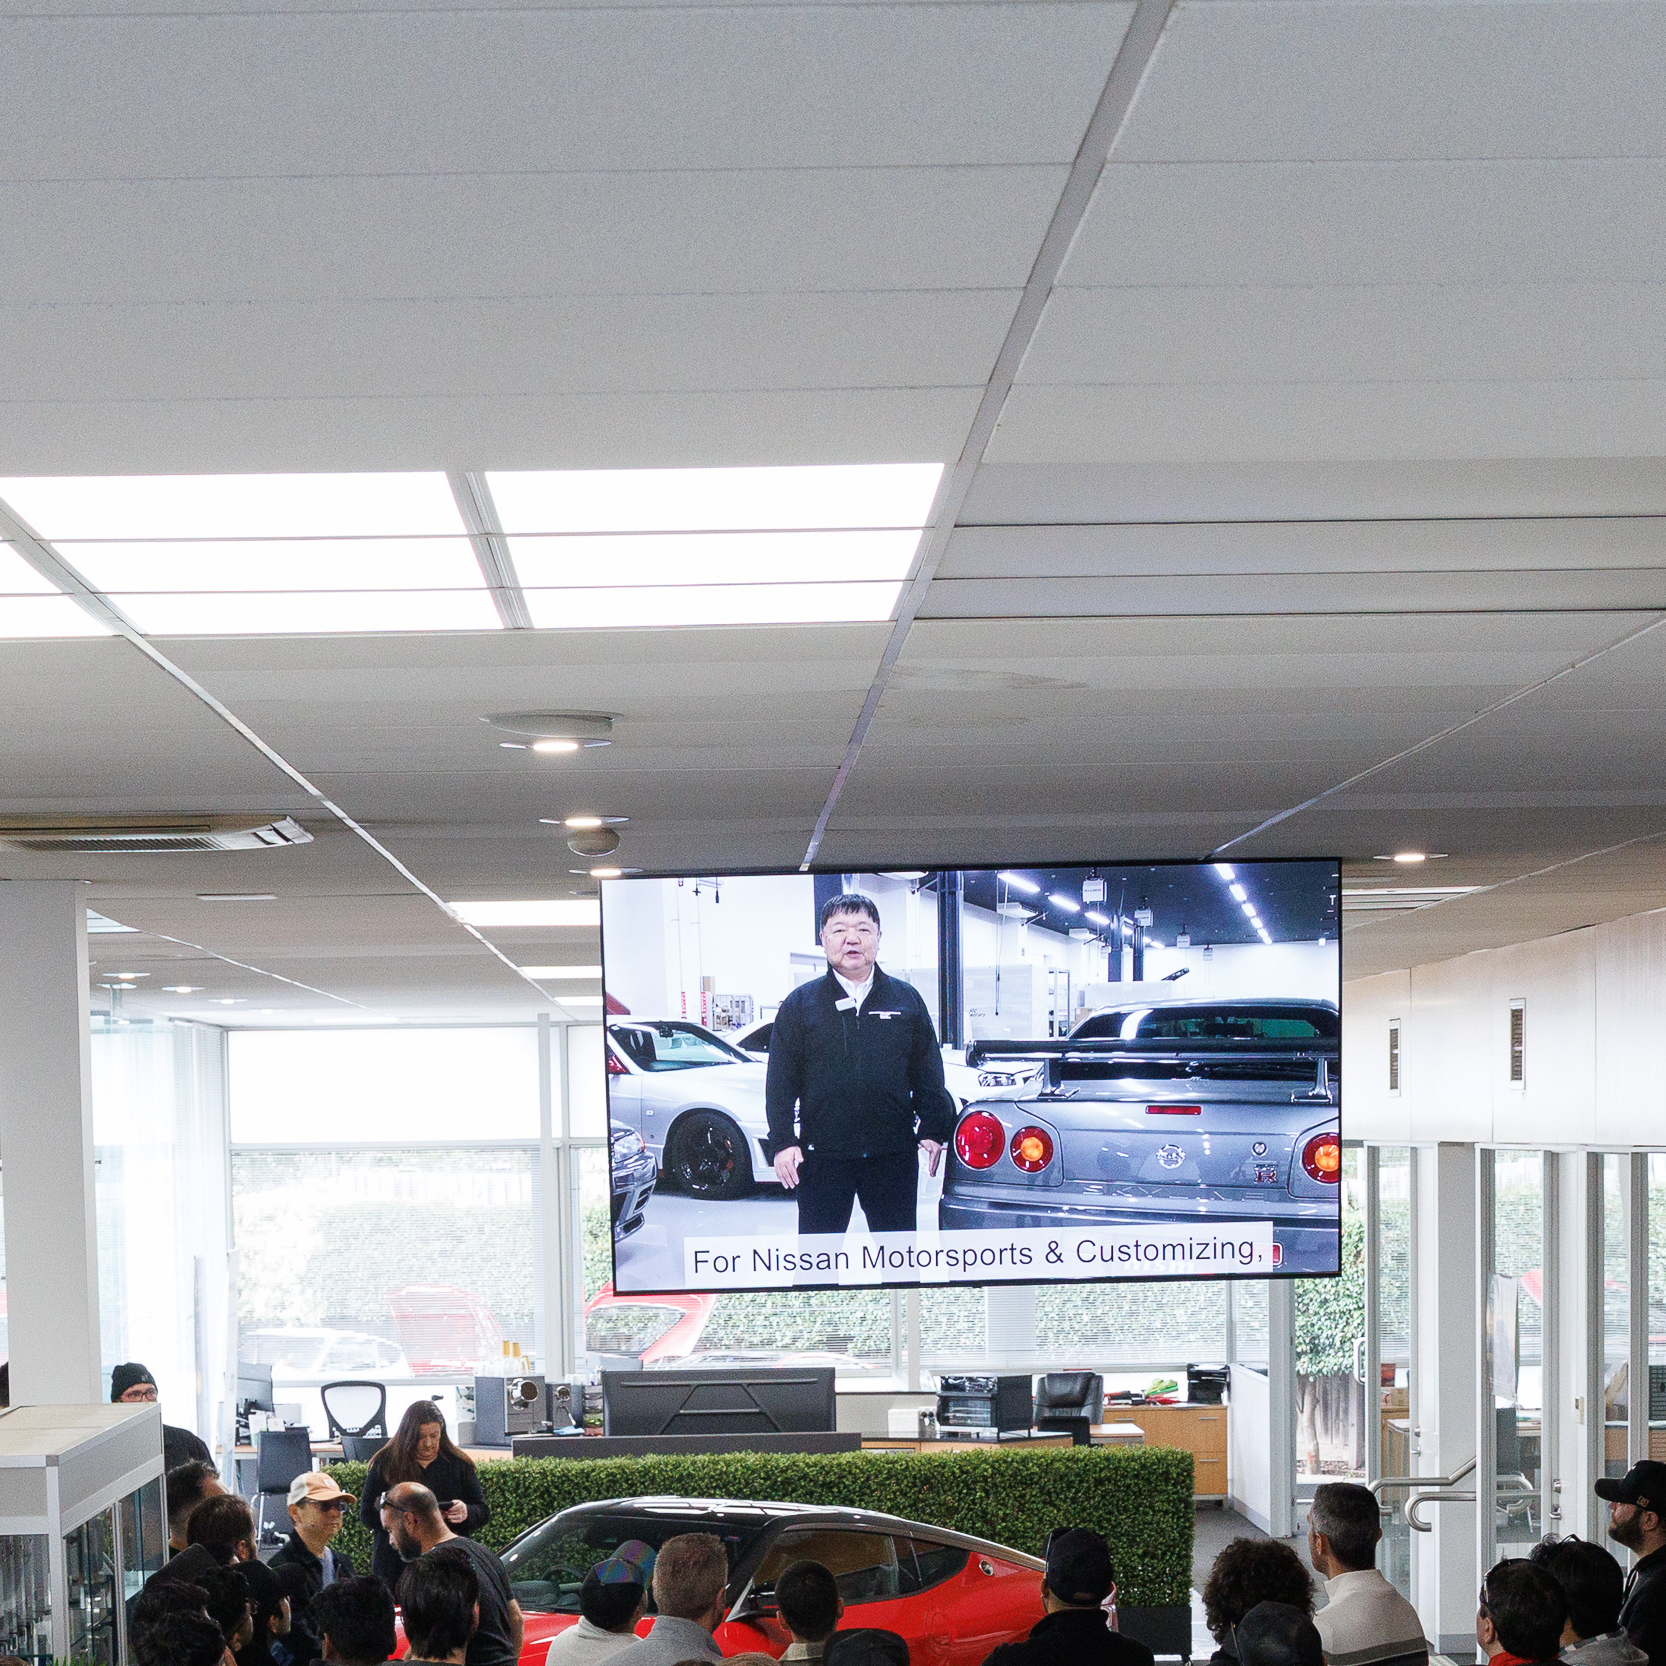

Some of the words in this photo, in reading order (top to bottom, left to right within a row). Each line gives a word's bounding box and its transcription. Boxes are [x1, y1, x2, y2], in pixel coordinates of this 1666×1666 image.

[693, 1249, 740, 1274] For
[752, 1246, 849, 1273] Nissan
[861, 1241, 1034, 1275] Motorsports
[1045, 1239, 1064, 1264] &
[1076, 1237, 1263, 1265] Customizing,
